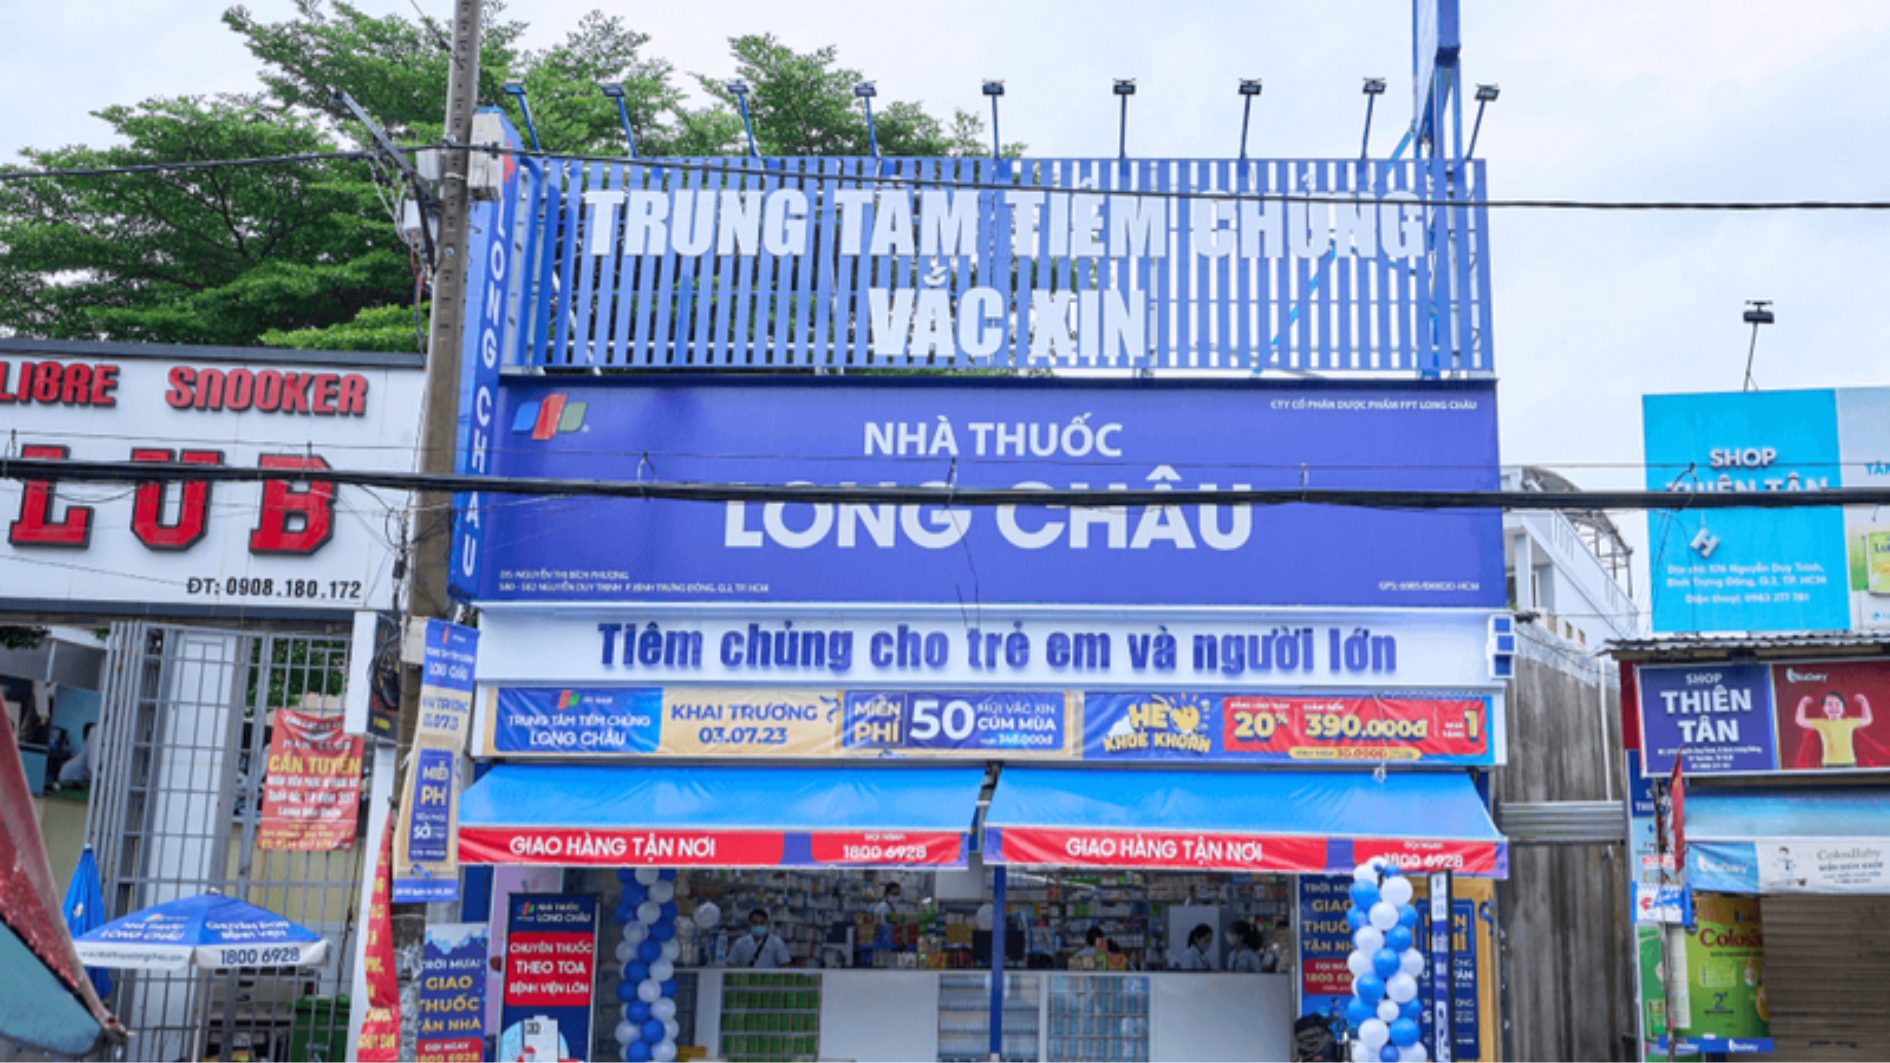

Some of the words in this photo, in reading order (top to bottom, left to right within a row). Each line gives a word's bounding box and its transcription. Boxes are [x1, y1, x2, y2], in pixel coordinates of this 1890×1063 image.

[585, 188, 808, 256] TRUNG
[834, 175, 979, 257] TÂM
[1193, 172, 1424, 259] CHỦNG
[868, 263, 1004, 358] VẮC
[1030, 289, 1146, 359] XIN
[863, 415, 959, 456] NHÀ
[968, 412, 1123, 458] THUỐC
[1709, 447, 1778, 470] SHOP
[724, 480, 973, 549] LONG
[996, 464, 1253, 551] CHÂU
[186, 577, 220, 595] ĐT:
[225, 576, 362, 599] 0908.180.172
[598, 621, 703, 667] Tiêm
[719, 619, 853, 671] chủng
[870, 624, 949, 669] cho
[967, 620, 1030, 669] trẻ
[1045, 631, 1112, 670] em
[1127, 623, 1177, 670] và
[1193, 625, 1314, 675] người
[1329, 626, 1398, 672] lớn
[1686, 672, 1723, 685] SHOP
[1034, 703, 1056, 715] XIN
[1660, 685, 1753, 715] THIÊN
[671, 704, 724, 721] KHAI
[728, 702, 818, 722] TRƯƠNG
[909, 699, 975, 741] 50
[698, 726, 787, 744] 03.07.23
[1233, 710, 1289, 740] 20%
[1463, 709, 1479, 740] 1
[1677, 715, 1740, 744] TÂN
[529, 730, 577, 747] LONG
[579, 728, 626, 746] CHÂU
[510, 836, 562, 856] GIAO
[566, 833, 627, 857] HÀNG
[632, 834, 674, 863] TẬN
[677, 835, 715, 858] NƠI
[843, 844, 882, 859] 1800
[885, 844, 927, 860] 6928
[1065, 837, 1117, 857] GIAO
[1120, 834, 1178, 859] HÀNG
[1182, 837, 1219, 866] TẬN
[1221, 840, 1263, 862] NƠI
[1424, 853, 1463, 869] 6928
[220, 949, 256, 965] 1800
[261, 946, 301, 964] 6928
[510, 940, 554, 954] CHUYÊN
[556, 938, 593, 954] THUỐC
[515, 961, 554, 975] THEO
[557, 961, 587, 975] TOA
[425, 976, 473, 991] GIAO
